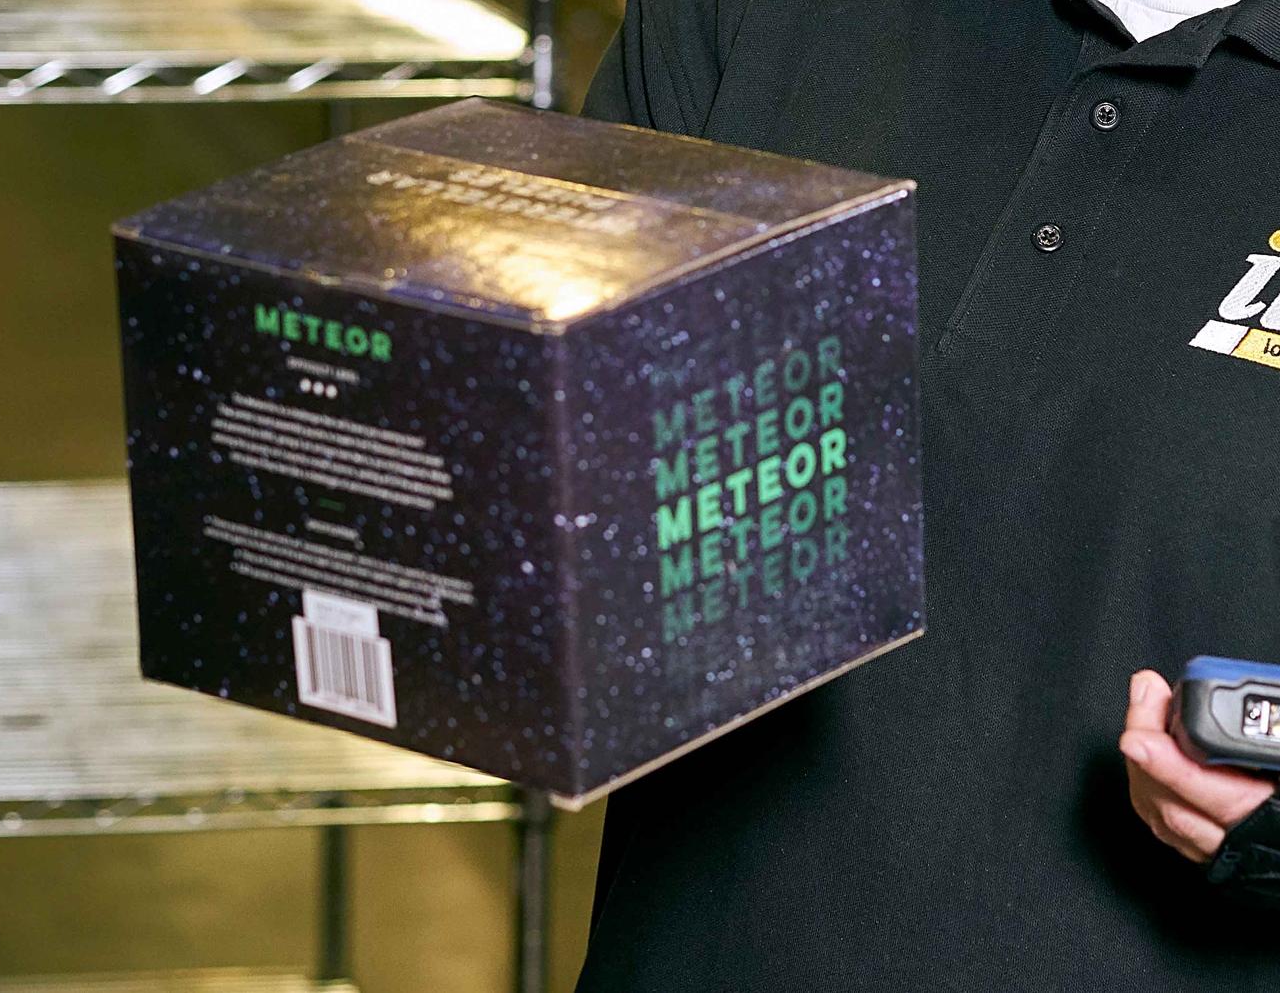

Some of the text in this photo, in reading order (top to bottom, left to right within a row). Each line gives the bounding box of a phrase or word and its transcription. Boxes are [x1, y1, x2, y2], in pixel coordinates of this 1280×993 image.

[255, 304, 392, 362] METEOR
[654, 335, 842, 451] METEOR
[656, 382, 845, 500] METEOR
[657, 428, 847, 550] METEOR
[660, 476, 849, 598] METEOR
[662, 520, 850, 644] METEOR
